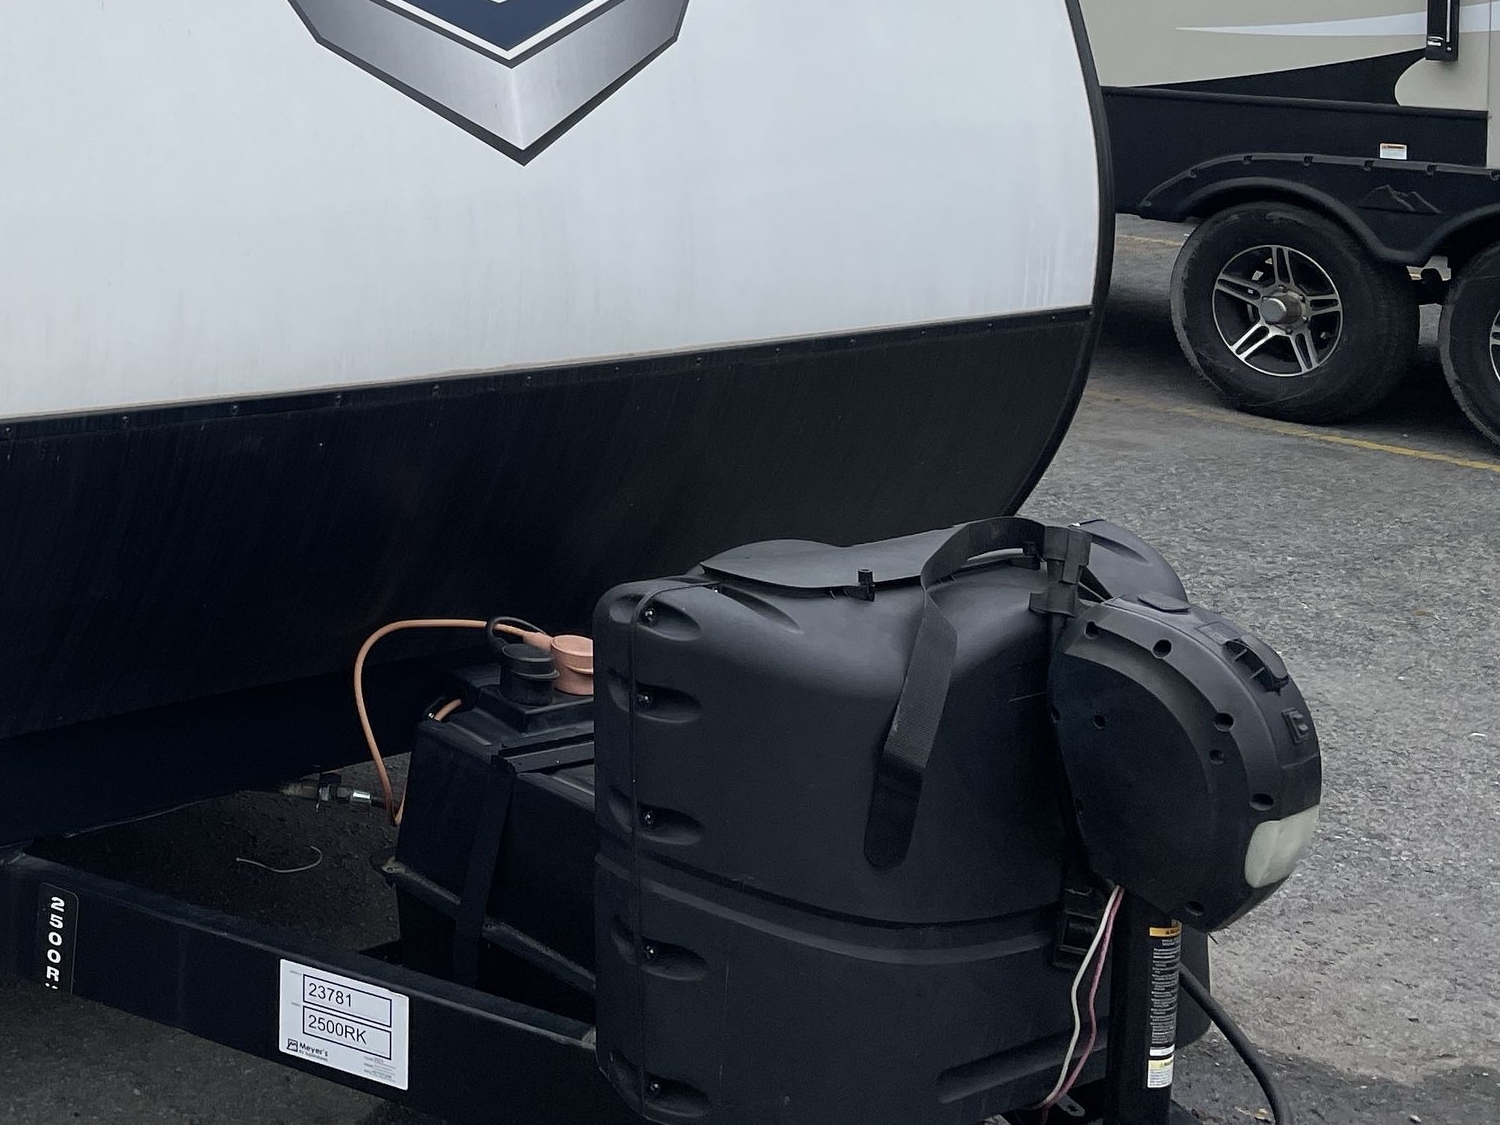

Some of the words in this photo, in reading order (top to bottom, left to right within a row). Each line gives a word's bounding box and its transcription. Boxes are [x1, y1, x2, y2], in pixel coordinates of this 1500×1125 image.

[308, 982, 352, 1007] 23781
[308, 1014, 367, 1045] 2500RK
[299, 1042, 328, 1057] Meyer's
